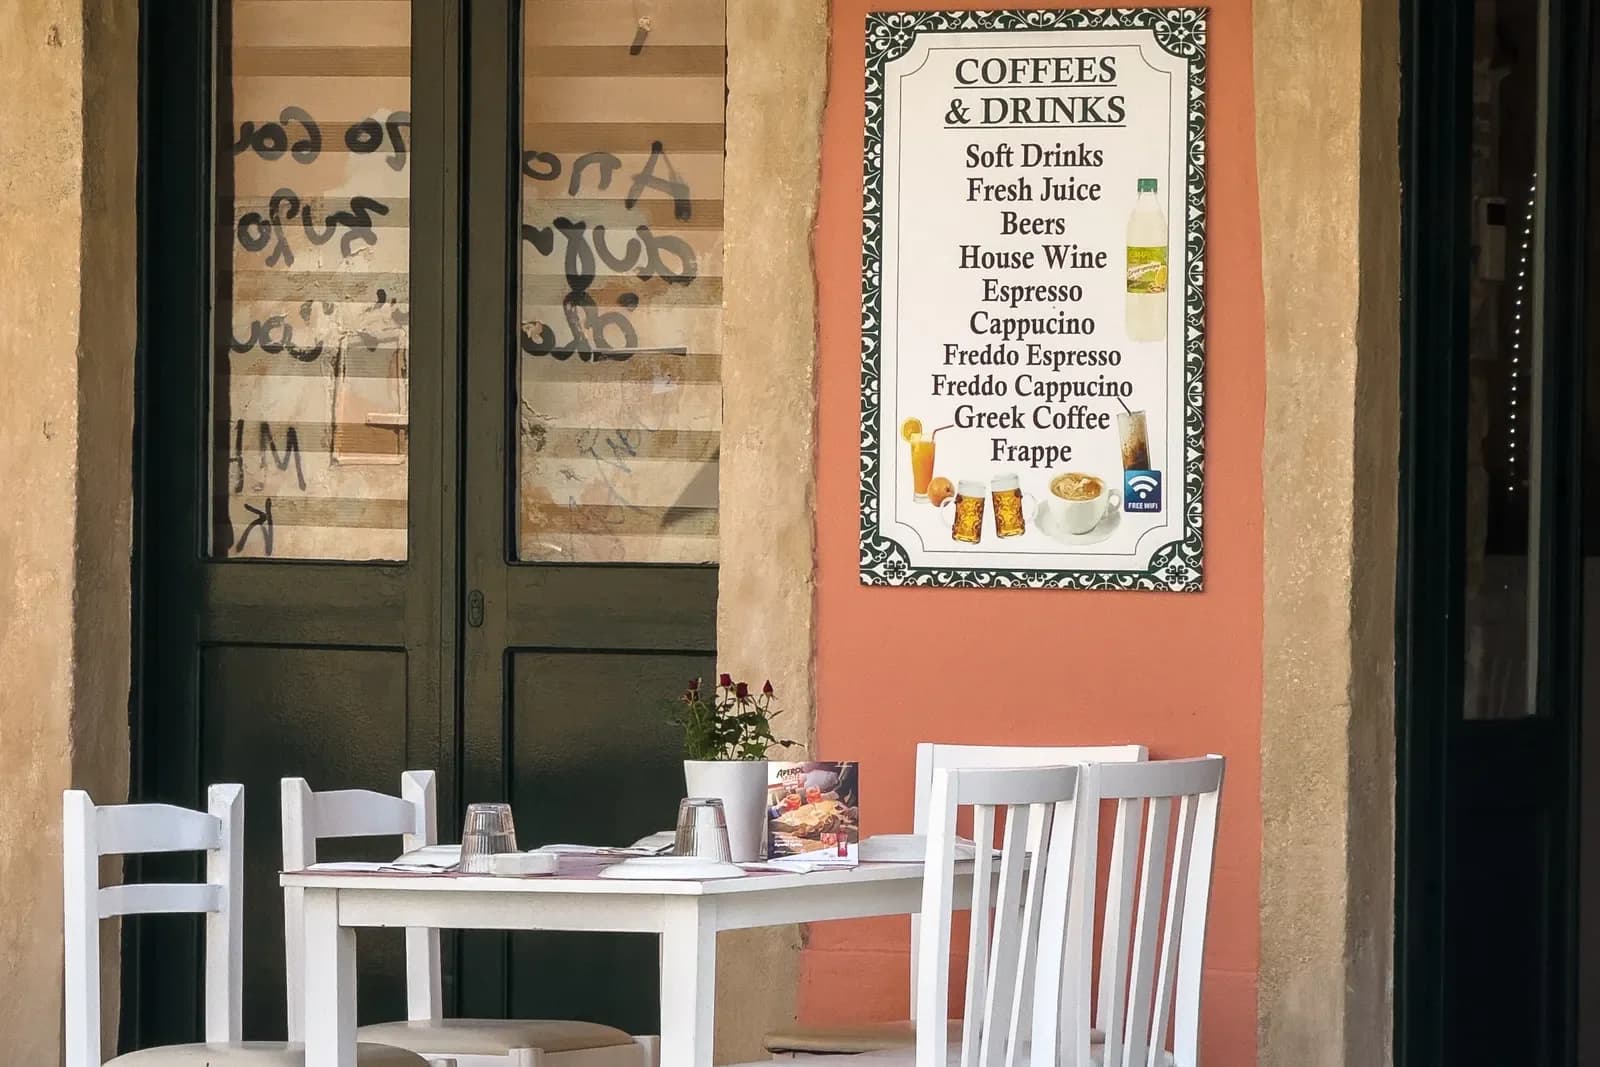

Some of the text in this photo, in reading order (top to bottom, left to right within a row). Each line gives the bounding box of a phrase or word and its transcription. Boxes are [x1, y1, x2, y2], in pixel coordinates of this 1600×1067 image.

[955, 55, 1117, 85] COFFEES
[944, 95, 1126, 125] & DRINKS
[966, 142, 1104, 169] Soft Drinks
[966, 176, 1101, 202] Fresh Juice
[999, 211, 1066, 236] Beers
[958, 244, 1035, 270] House
[1041, 244, 1108, 269] Wine
[981, 278, 1083, 308] Espresso
[970, 310, 1095, 342] Cappucino
[943, 343, 1122, 372] Freddo Espresso
[931, 374, 1133, 403] Freddo Cappucino
[953, 404, 1110, 430] Greek Coffee
[990, 438, 1072, 469] Frappe
